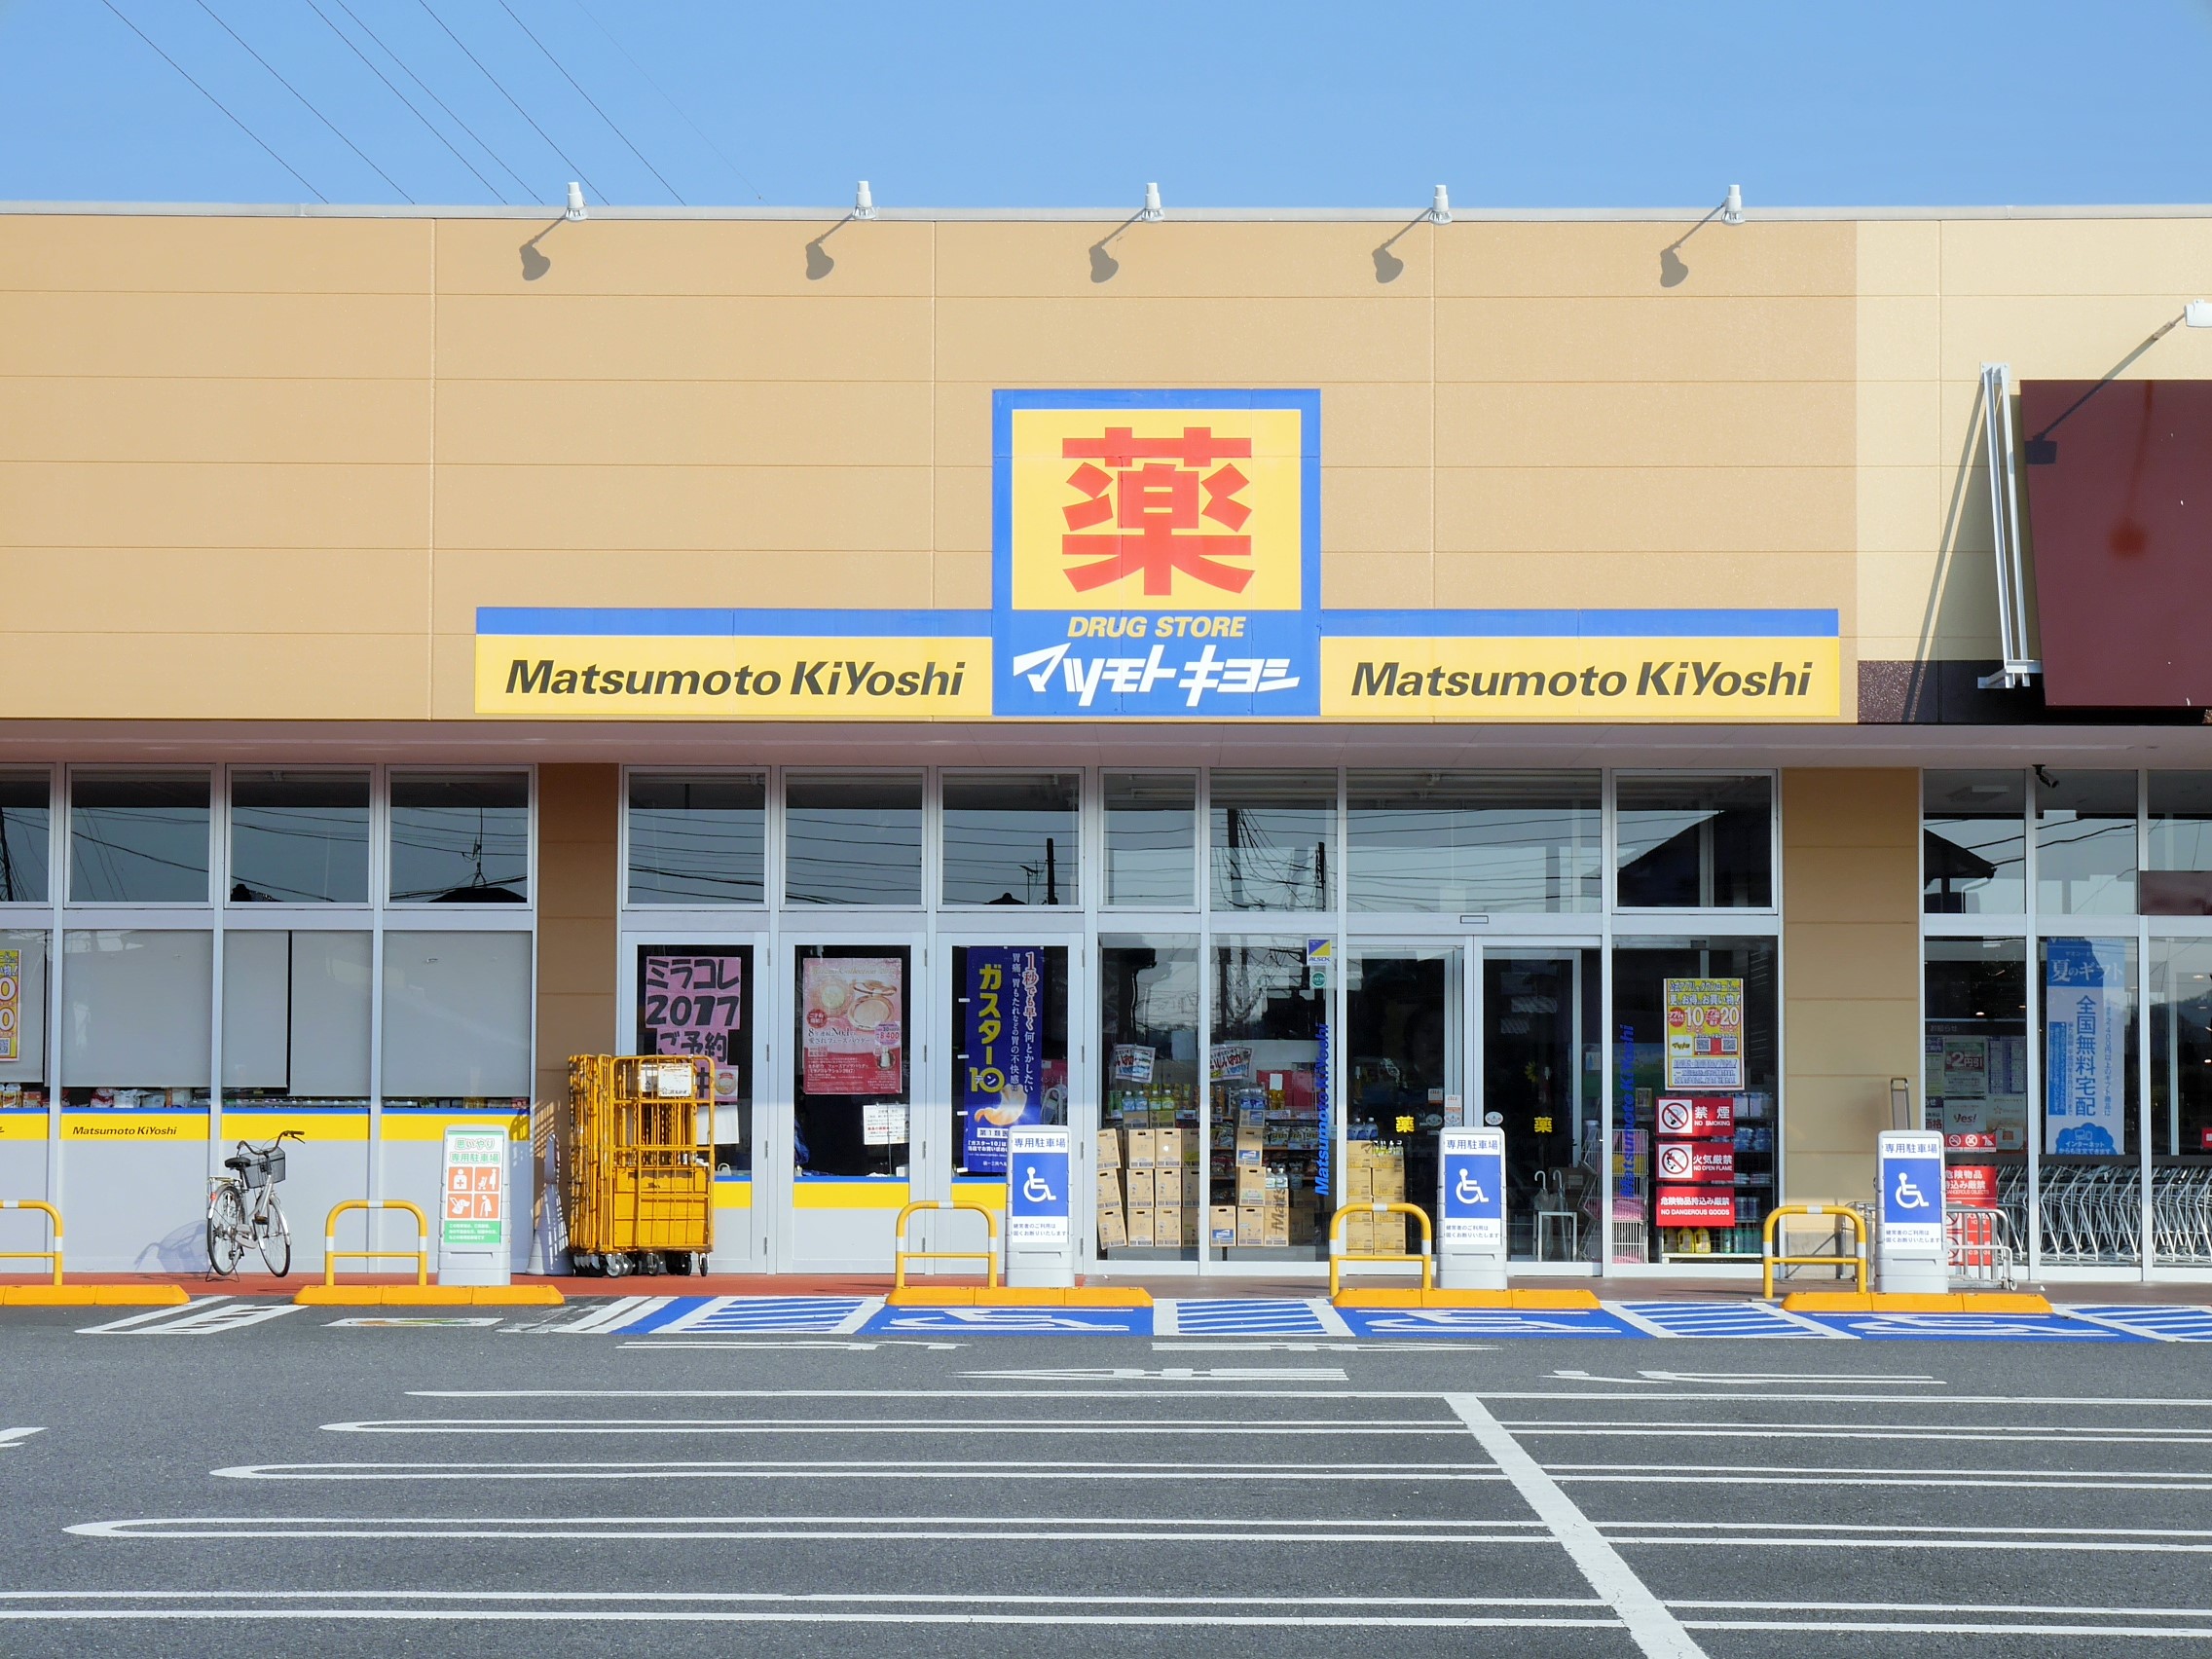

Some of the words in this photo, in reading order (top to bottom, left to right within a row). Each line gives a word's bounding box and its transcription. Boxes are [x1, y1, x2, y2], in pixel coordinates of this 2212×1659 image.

[1062, 426, 1256, 596] 薬
[1067, 615, 1147, 639] DRUG
[1155, 615, 1247, 639] STORE
[504, 659, 781, 698] Matsumoto
[790, 661, 967, 698] KiYoshi
[1350, 661, 1628, 698] Matsumoto
[1636, 661, 1814, 698] KiYoshi
[646, 958, 740, 989] ミラコレ
[2050, 958, 2123, 982] 夏のギフト
[645, 995, 740, 1027] 2017
[1023, 951, 1039, 1093] 1秒でも早く何とかしたい
[657, 1030, 728, 1062] ご予約
[2076, 994, 2096, 1117] 全国無料宅配
[72, 1125, 135, 1135] Matsumoto
[137, 1125, 177, 1135] KiYoshi
[455, 1138, 495, 1150] 思いやり
[1014, 1137, 1066, 1149] 専用駐車場
[1314, 1092, 1329, 1197] Matsumoto
[1447, 1139, 1498, 1150] 専用駐車場
[1885, 1143, 1937, 1154] 専用駐車場
[450, 1152, 500, 1164] 専用駐車場
[1692, 1155, 1733, 1165] 火気厳禁
[1660, 1197, 1730, 1205] 危険物品持込み厳禁
